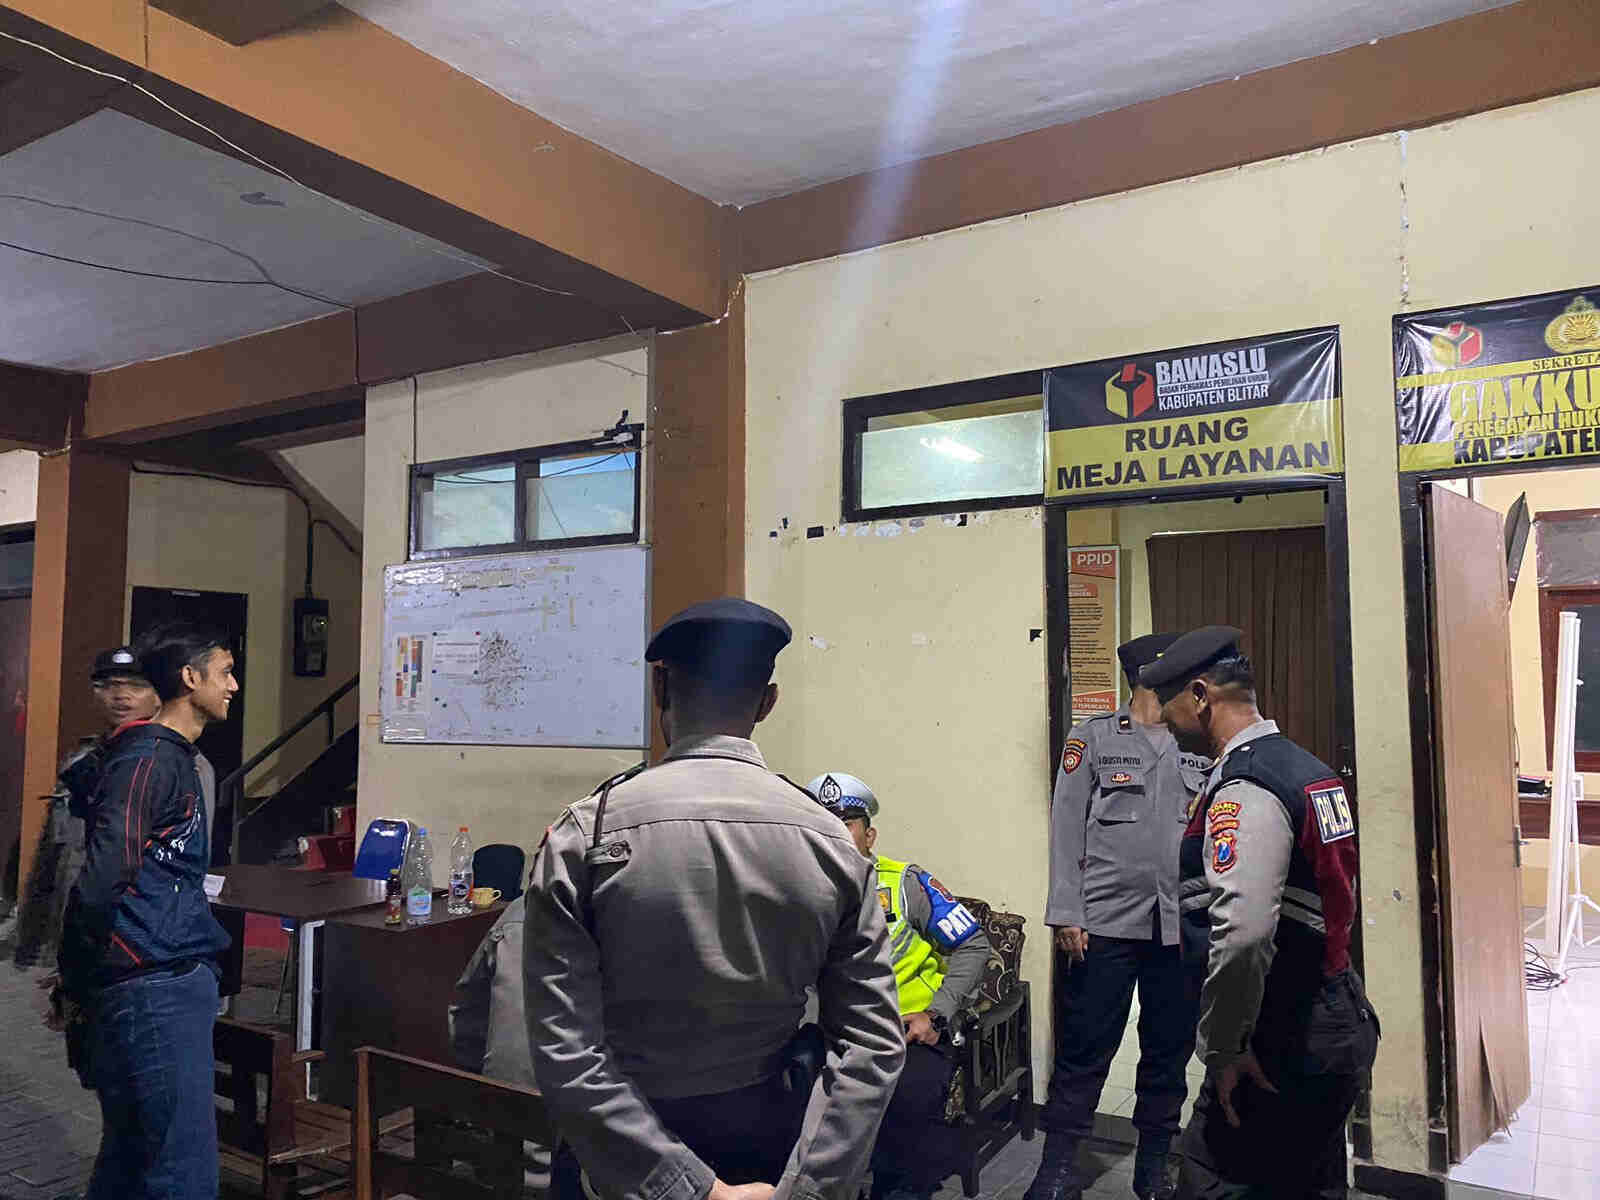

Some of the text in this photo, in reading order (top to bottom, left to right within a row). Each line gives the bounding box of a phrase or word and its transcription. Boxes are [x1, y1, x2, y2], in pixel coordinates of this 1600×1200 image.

[1155, 348, 1266, 385] BAWASLU
[1158, 384, 1269, 411] KABUPATEN BLITAR
[1125, 416, 1248, 452] RUANG
[1056, 440, 1330, 490] MEJA LAYANAN
[1076, 552, 1113, 566] PPID
